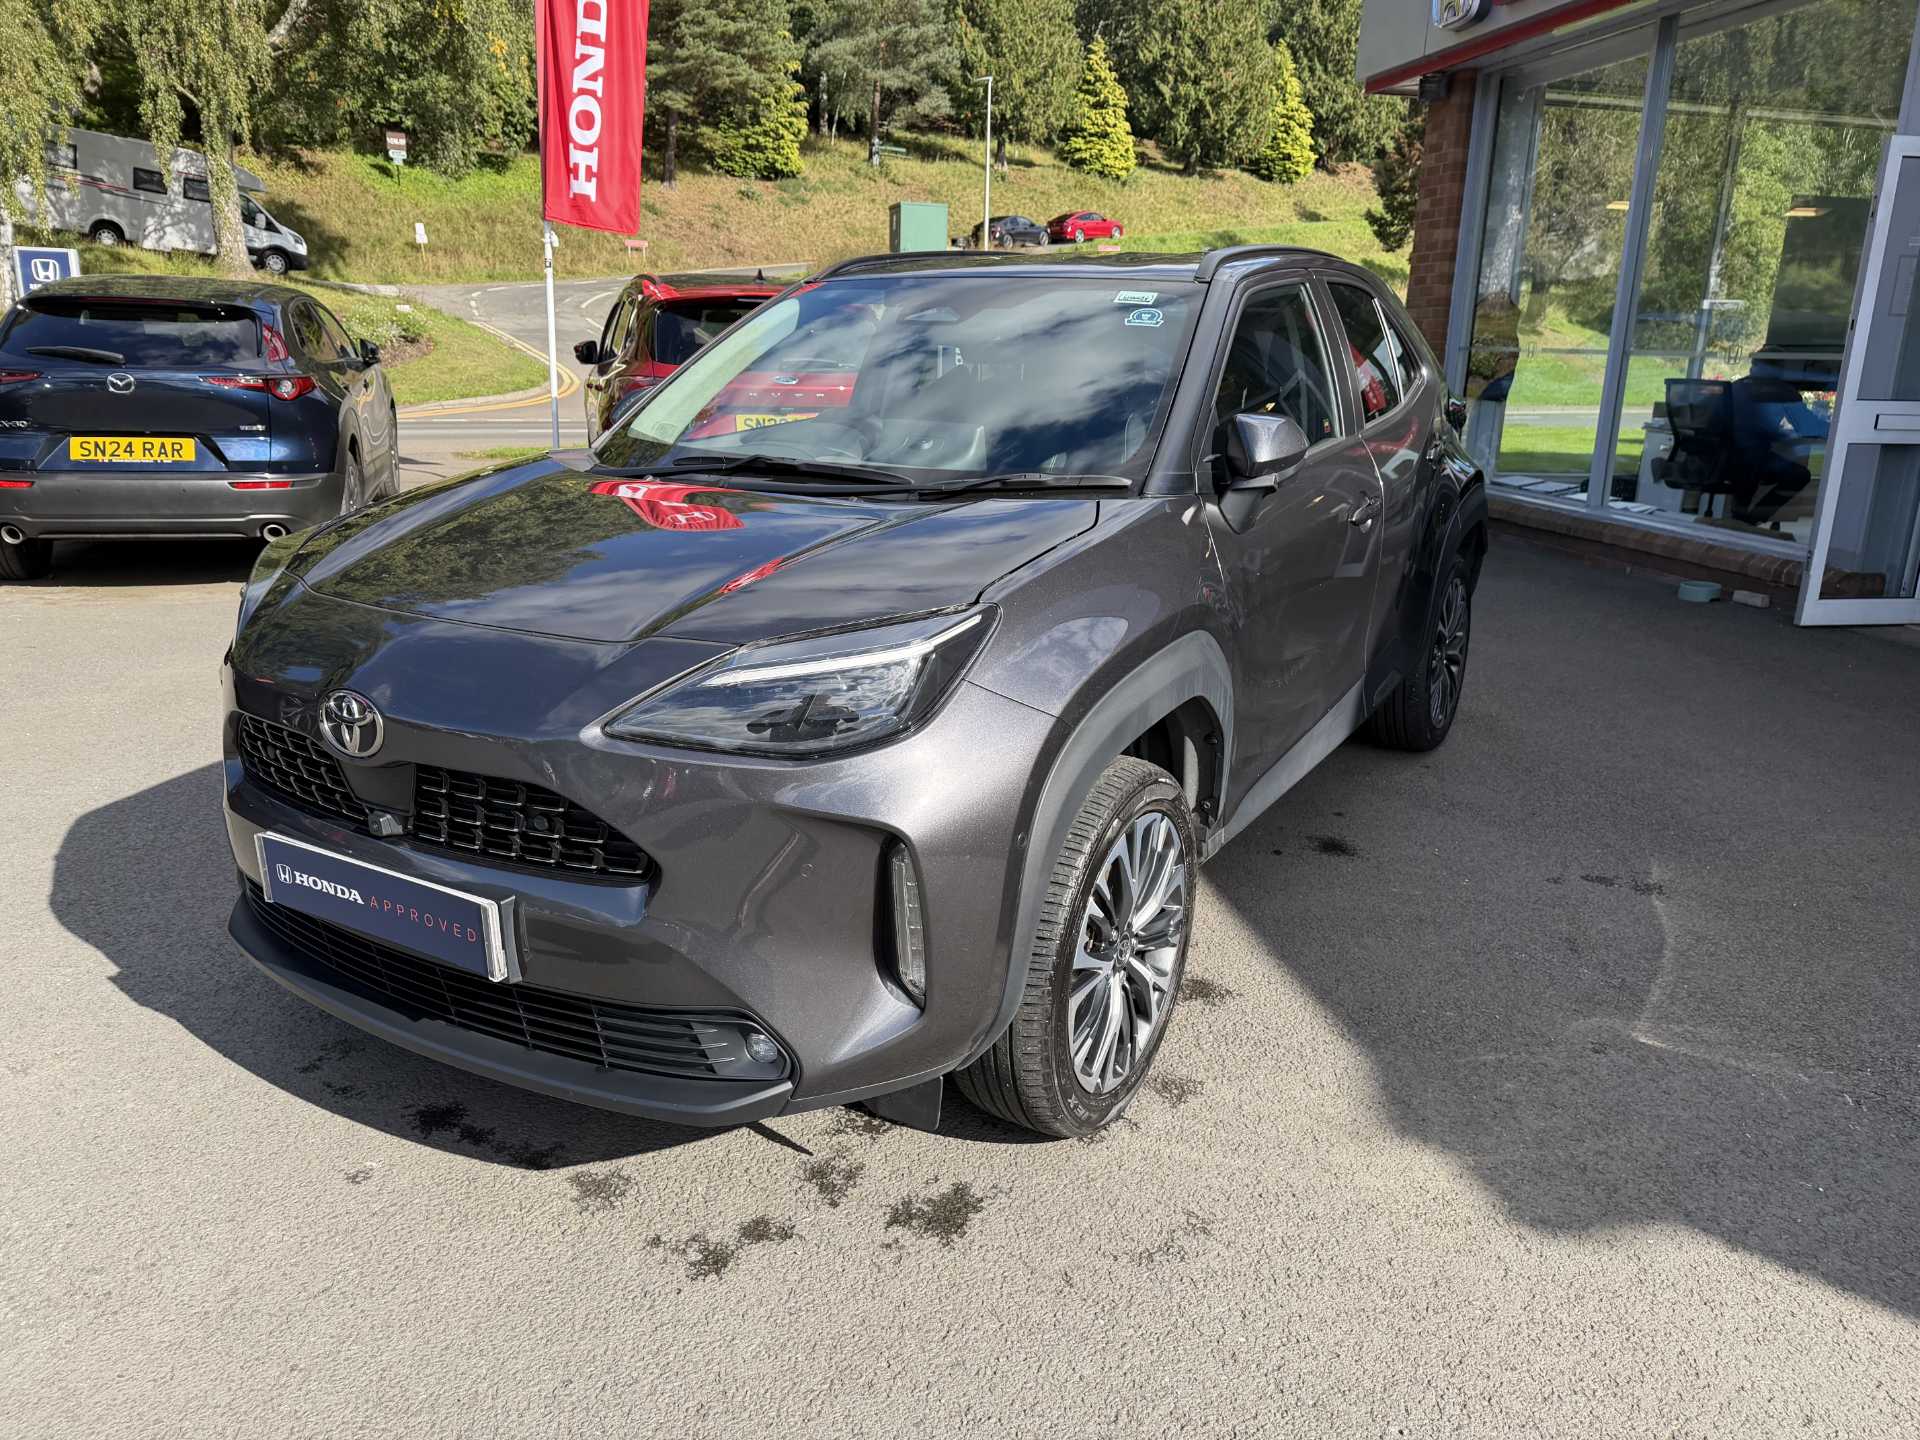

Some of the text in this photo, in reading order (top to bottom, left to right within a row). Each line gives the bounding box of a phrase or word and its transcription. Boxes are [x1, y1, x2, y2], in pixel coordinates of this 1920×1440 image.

[568, 0, 607, 203] HOND
[79, 440, 184, 459] SN24 RAR
[294, 870, 478, 943] HONDA APPROVED
